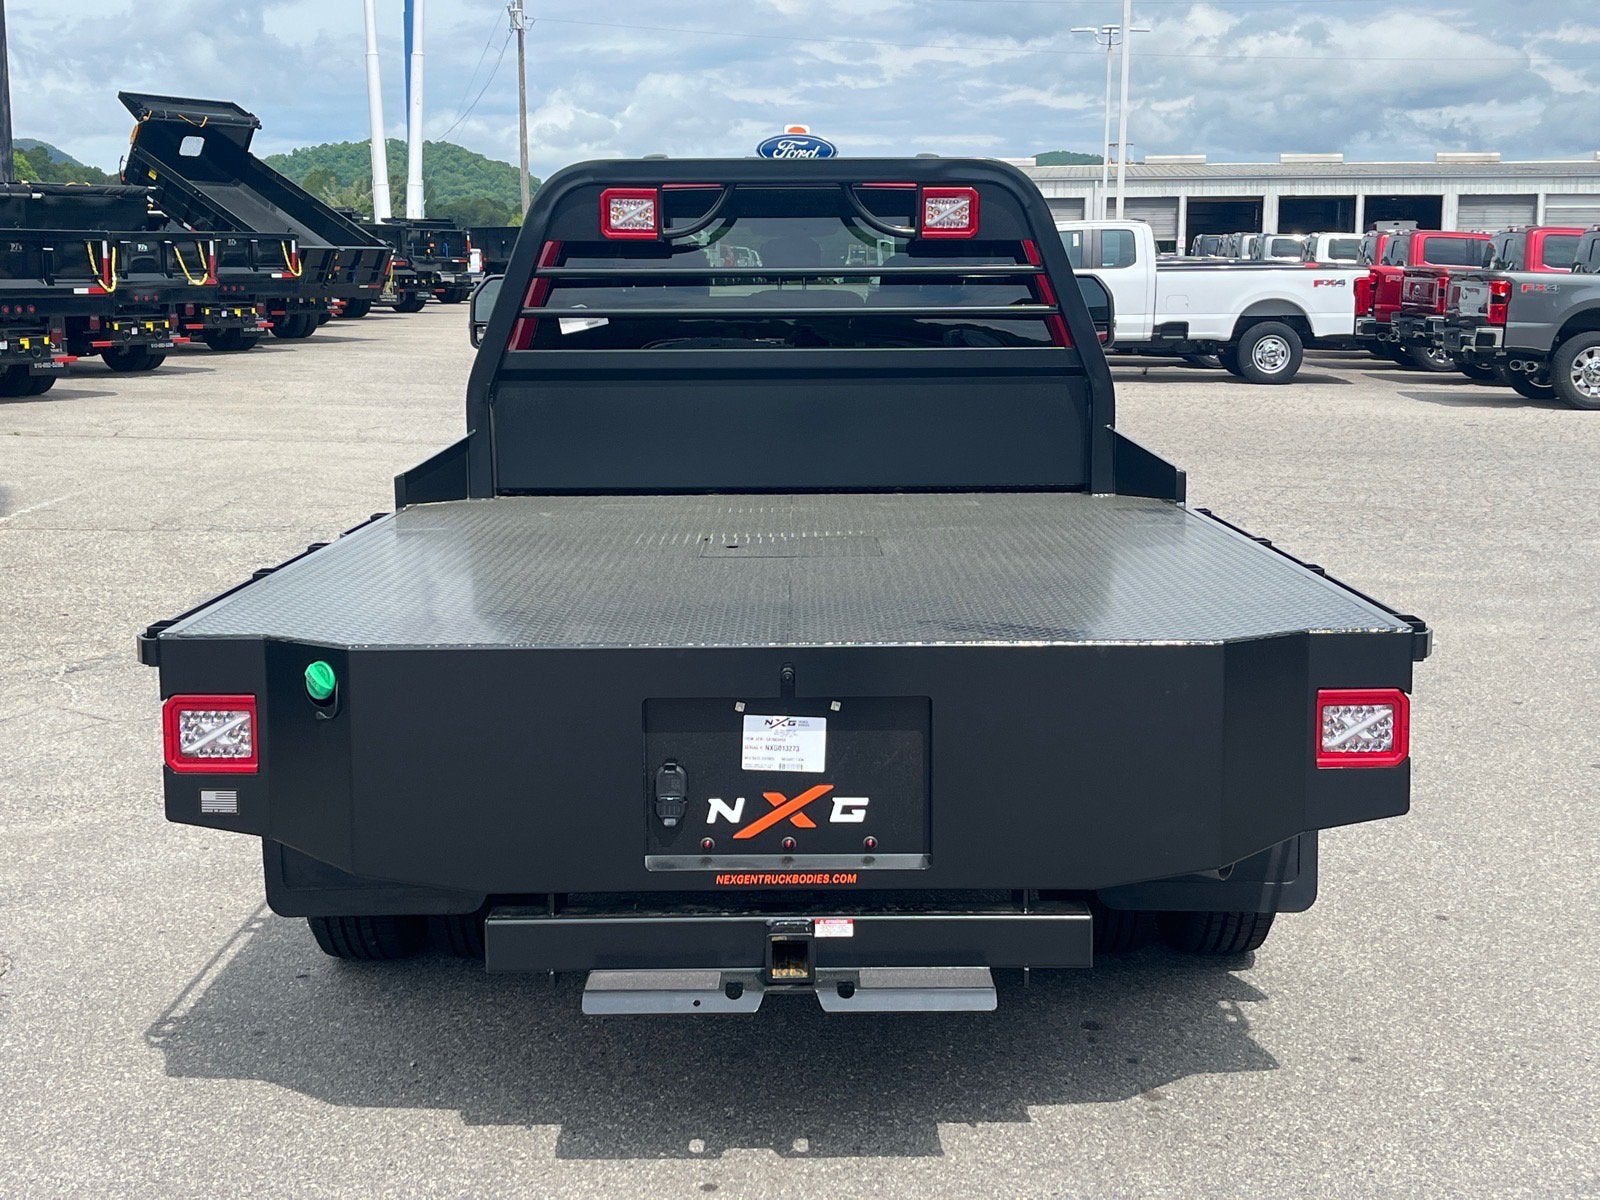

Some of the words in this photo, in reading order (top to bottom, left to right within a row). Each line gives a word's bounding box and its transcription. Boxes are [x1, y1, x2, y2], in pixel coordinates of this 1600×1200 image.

[773, 140, 820, 158] Ford
[1313, 279, 1346, 288] FX4
[1521, 283, 1560, 294] FX4
[706, 784, 870, 839] NXG
[715, 873, 858, 885] NEXGENTRUCKBODIES.COM
